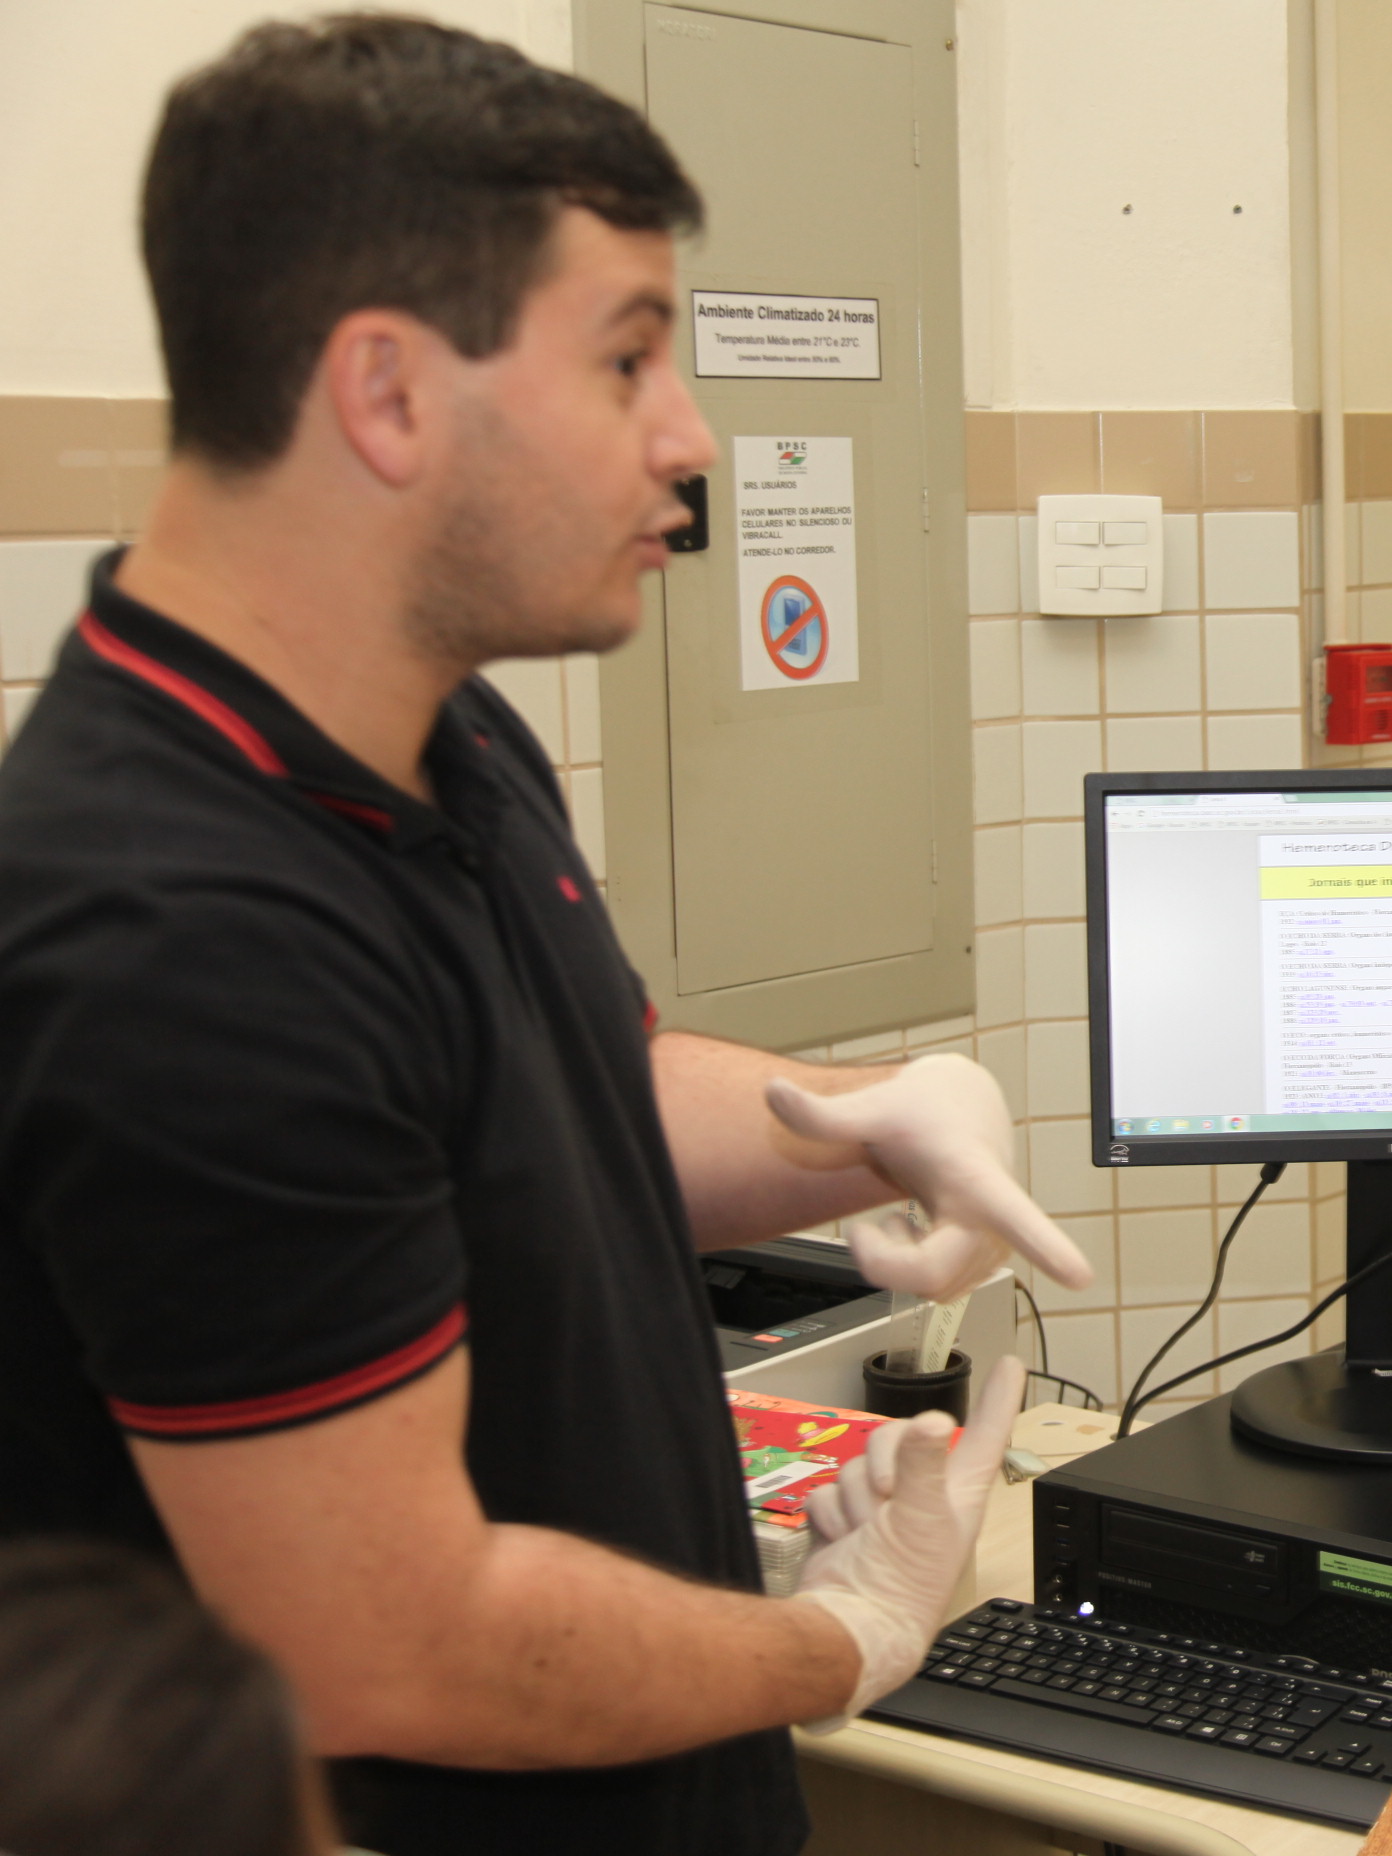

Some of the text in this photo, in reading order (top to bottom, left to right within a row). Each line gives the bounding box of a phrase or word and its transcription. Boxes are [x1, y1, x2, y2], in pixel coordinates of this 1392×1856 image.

[697, 303, 875, 324] Ambiente Climatizado 24 horas
[714, 333, 766, 346] Temperatura
[767, 335, 790, 346] Média
[792, 336, 811, 346] entre
[761, 480, 797, 489] USUÁRIOS
[741, 506, 851, 517] FAVOR MANTER OS APARELHOS
[742, 519, 783, 528] CELULARES
[799, 518, 840, 527] SILENCIOSO
[842, 517, 852, 525] OU
[743, 547, 783, 557] ATENDE-LO
[784, 547, 794, 555] NO
[1282, 841, 1377, 853] Hemeroteca
[1308, 877, 1351, 888] Jornais
[1356, 879, 1378, 889] que
